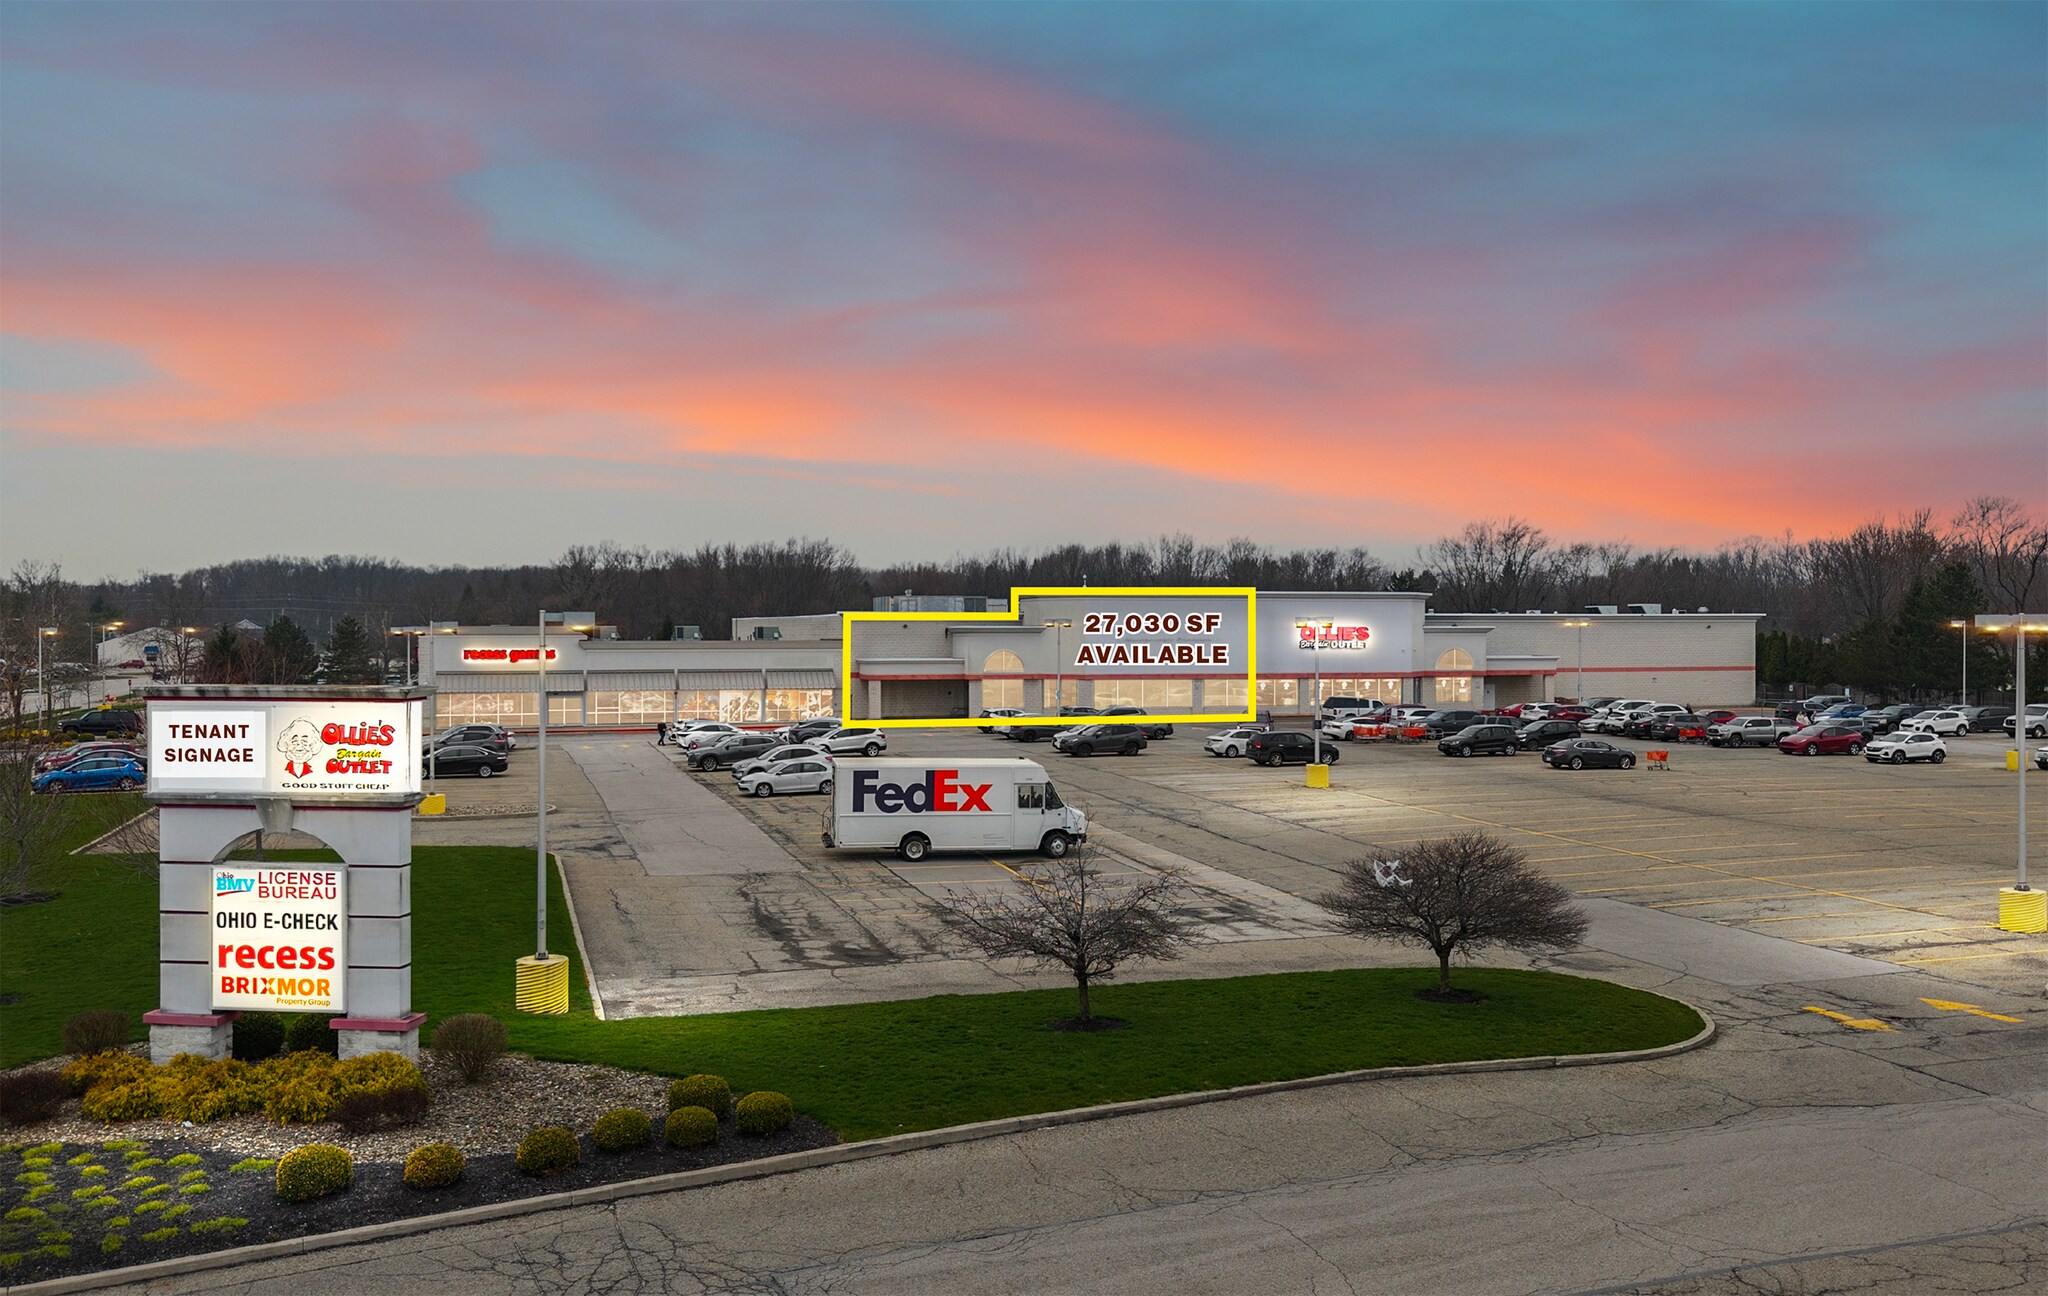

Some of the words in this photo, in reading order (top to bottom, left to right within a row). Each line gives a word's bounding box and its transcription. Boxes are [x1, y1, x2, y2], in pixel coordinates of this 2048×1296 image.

[463, 649, 508, 660] recess
[509, 649, 556, 663] gams
[168, 724, 250, 739] TENANT
[164, 748, 254, 763] SIGNAGE
[336, 748, 382, 760] Bargain
[325, 758, 393, 774] OUTLET
[852, 770, 993, 813] FedEx
[216, 871, 235, 879] Ohio
[258, 872, 336, 885] LICENSE
[216, 878, 255, 892] BMV
[258, 886, 337, 899] BUREAU
[216, 911, 257, 929] OHIO
[264, 912, 338, 930] E-CHECK
[218, 944, 335, 970] recess
[221, 976, 331, 996] BRIXMOR
